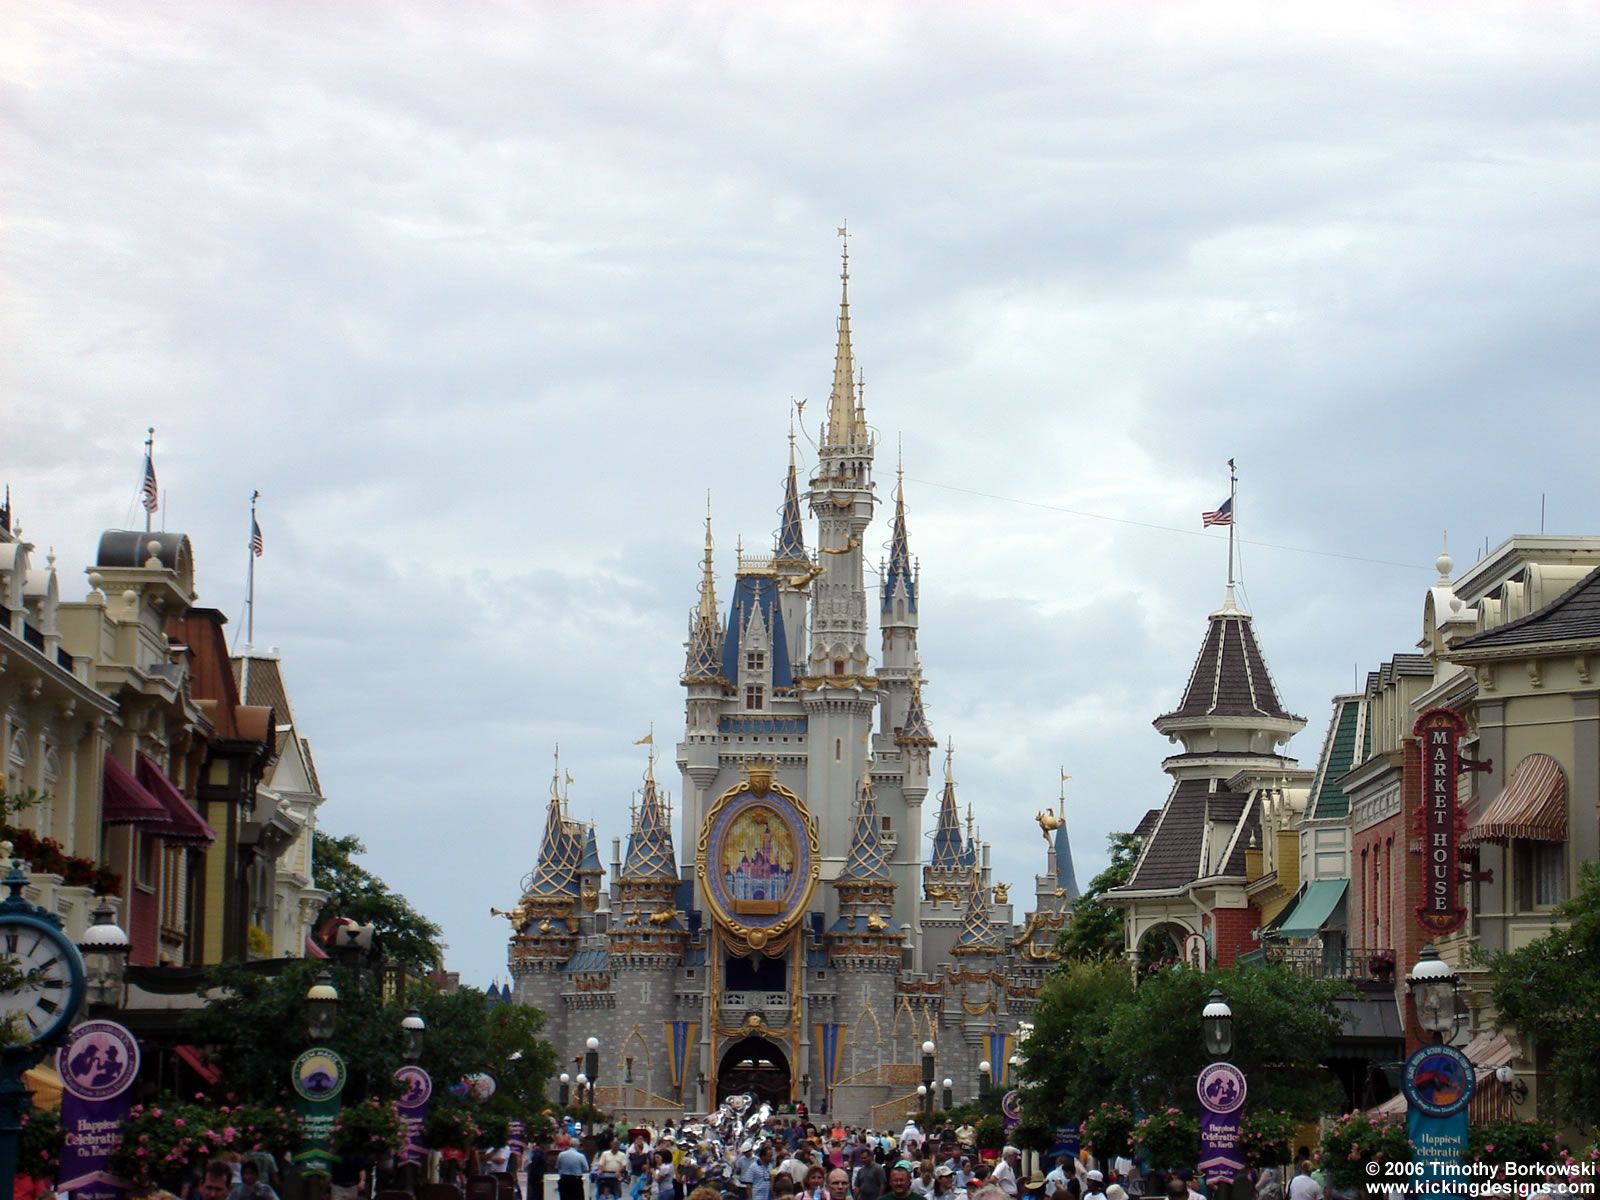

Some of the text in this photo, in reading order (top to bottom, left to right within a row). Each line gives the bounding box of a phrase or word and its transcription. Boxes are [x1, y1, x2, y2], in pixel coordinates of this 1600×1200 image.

[1432, 731, 1447, 910] MARKET HOUSE
[1209, 1123, 1236, 1134] Happiest
[1422, 1133, 1461, 1146] Happiest
[78, 1148, 90, 1157] On
